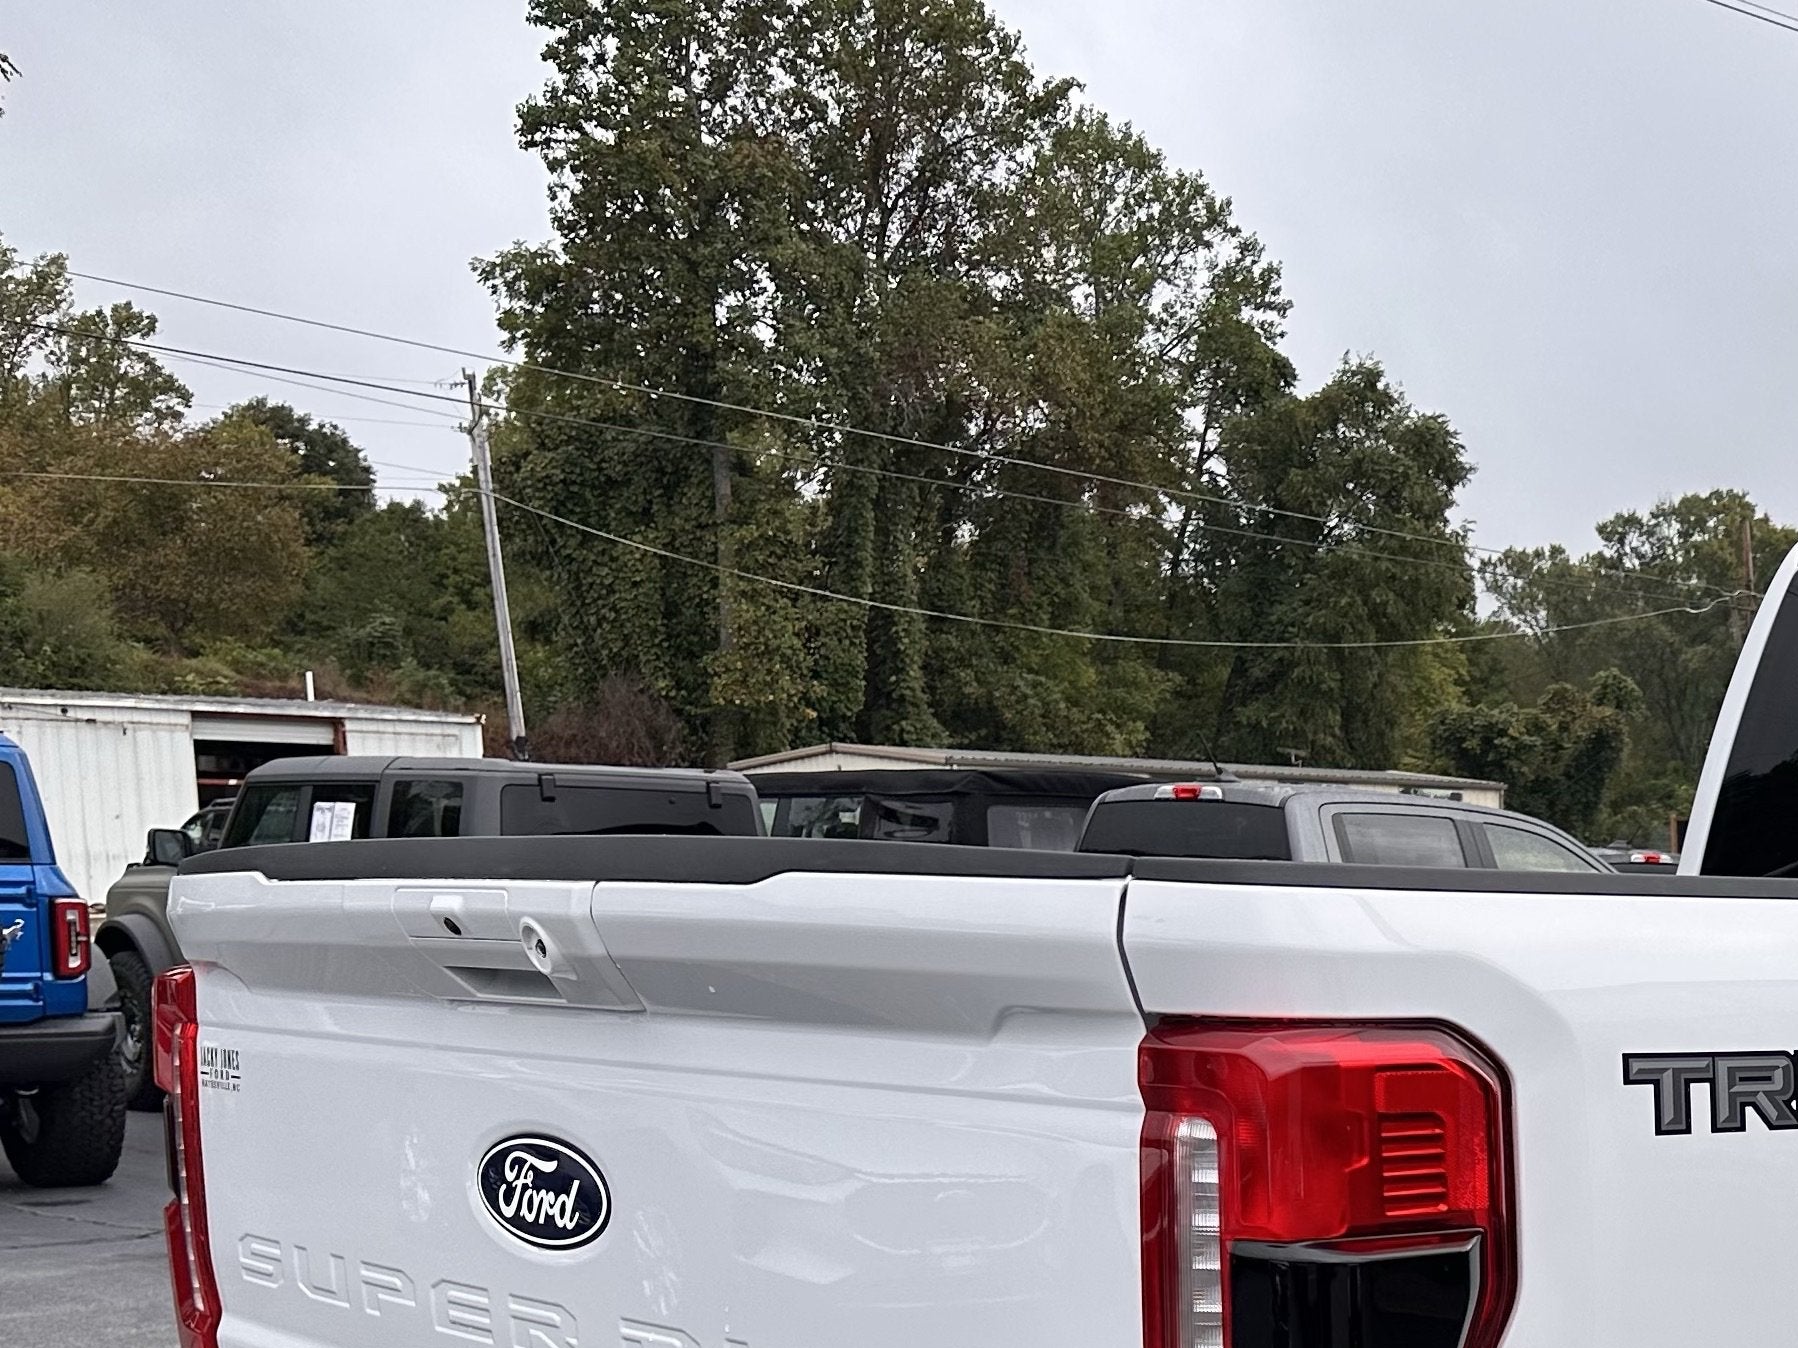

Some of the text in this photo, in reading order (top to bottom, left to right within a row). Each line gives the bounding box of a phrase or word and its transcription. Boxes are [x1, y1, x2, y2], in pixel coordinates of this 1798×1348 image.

[200, 1046, 240, 1071] JACKY JONES
[210, 1068, 230, 1081] FORD
[498, 1150, 581, 1230] Ford
